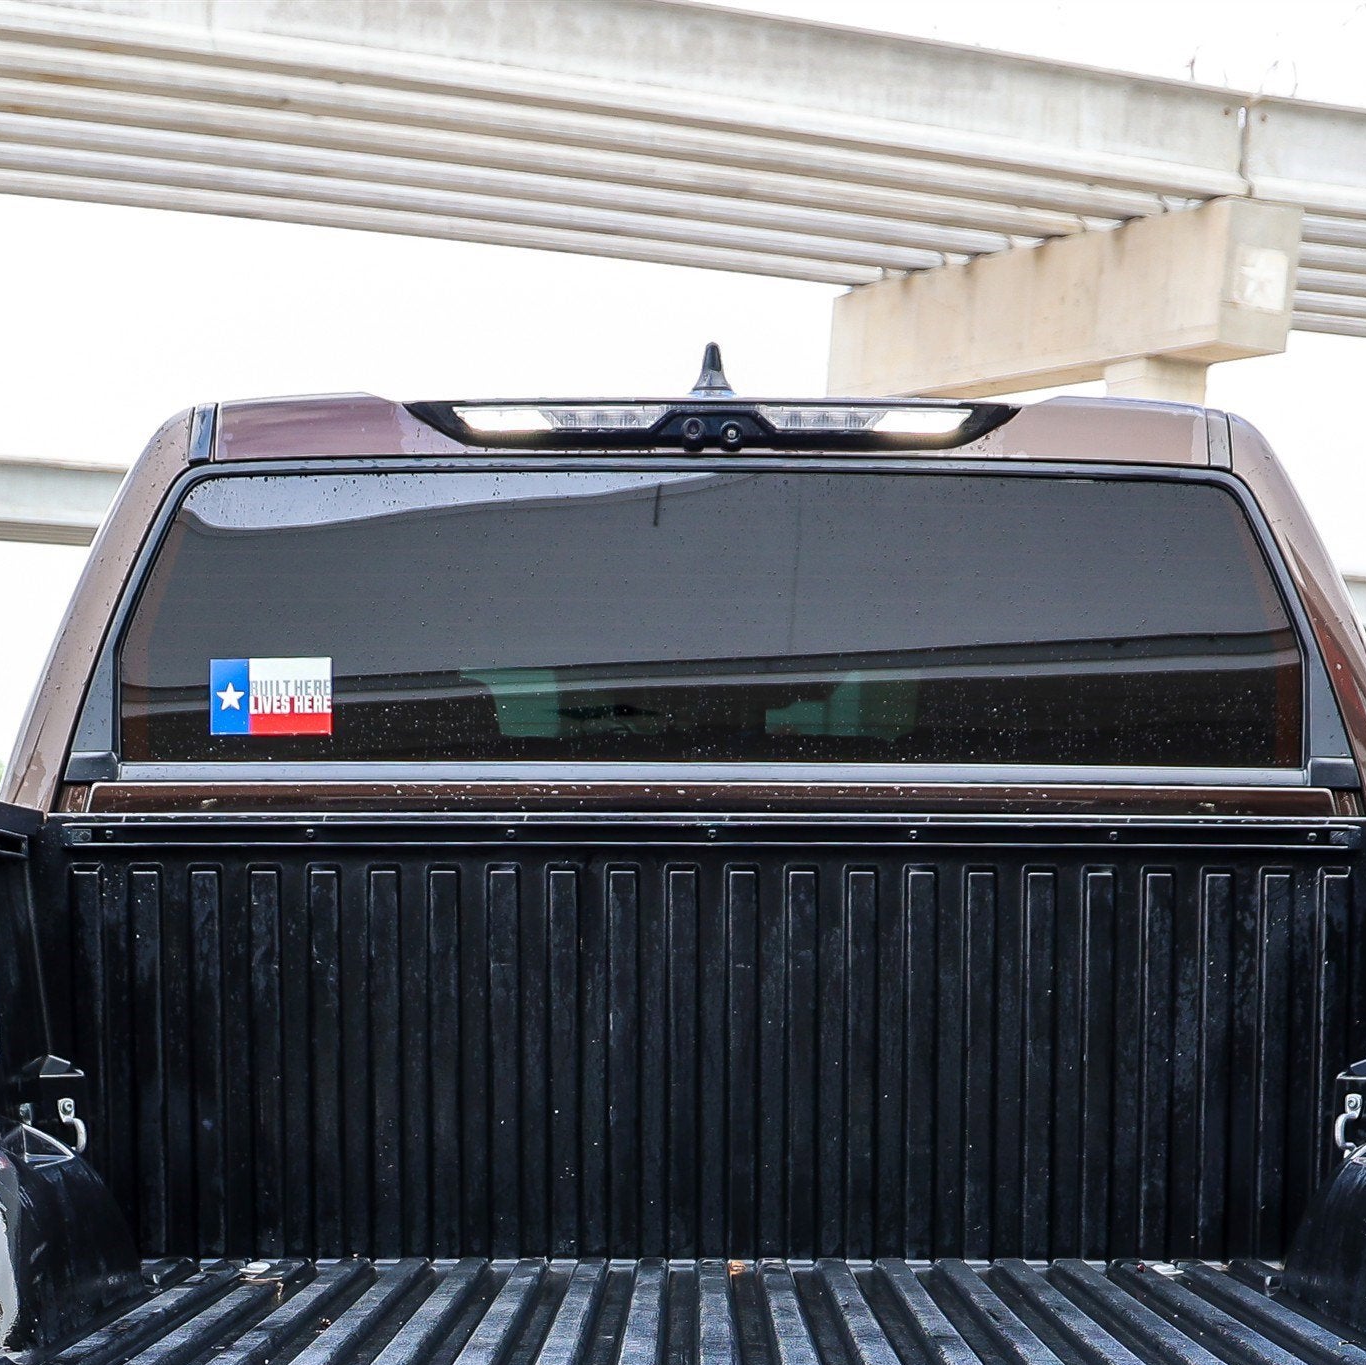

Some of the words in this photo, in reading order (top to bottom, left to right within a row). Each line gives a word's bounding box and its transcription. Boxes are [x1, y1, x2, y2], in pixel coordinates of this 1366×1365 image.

[250, 679, 291, 696] BUILT
[294, 679, 331, 696] HERE
[249, 695, 291, 714] LIVES
[294, 695, 332, 713] HERE
